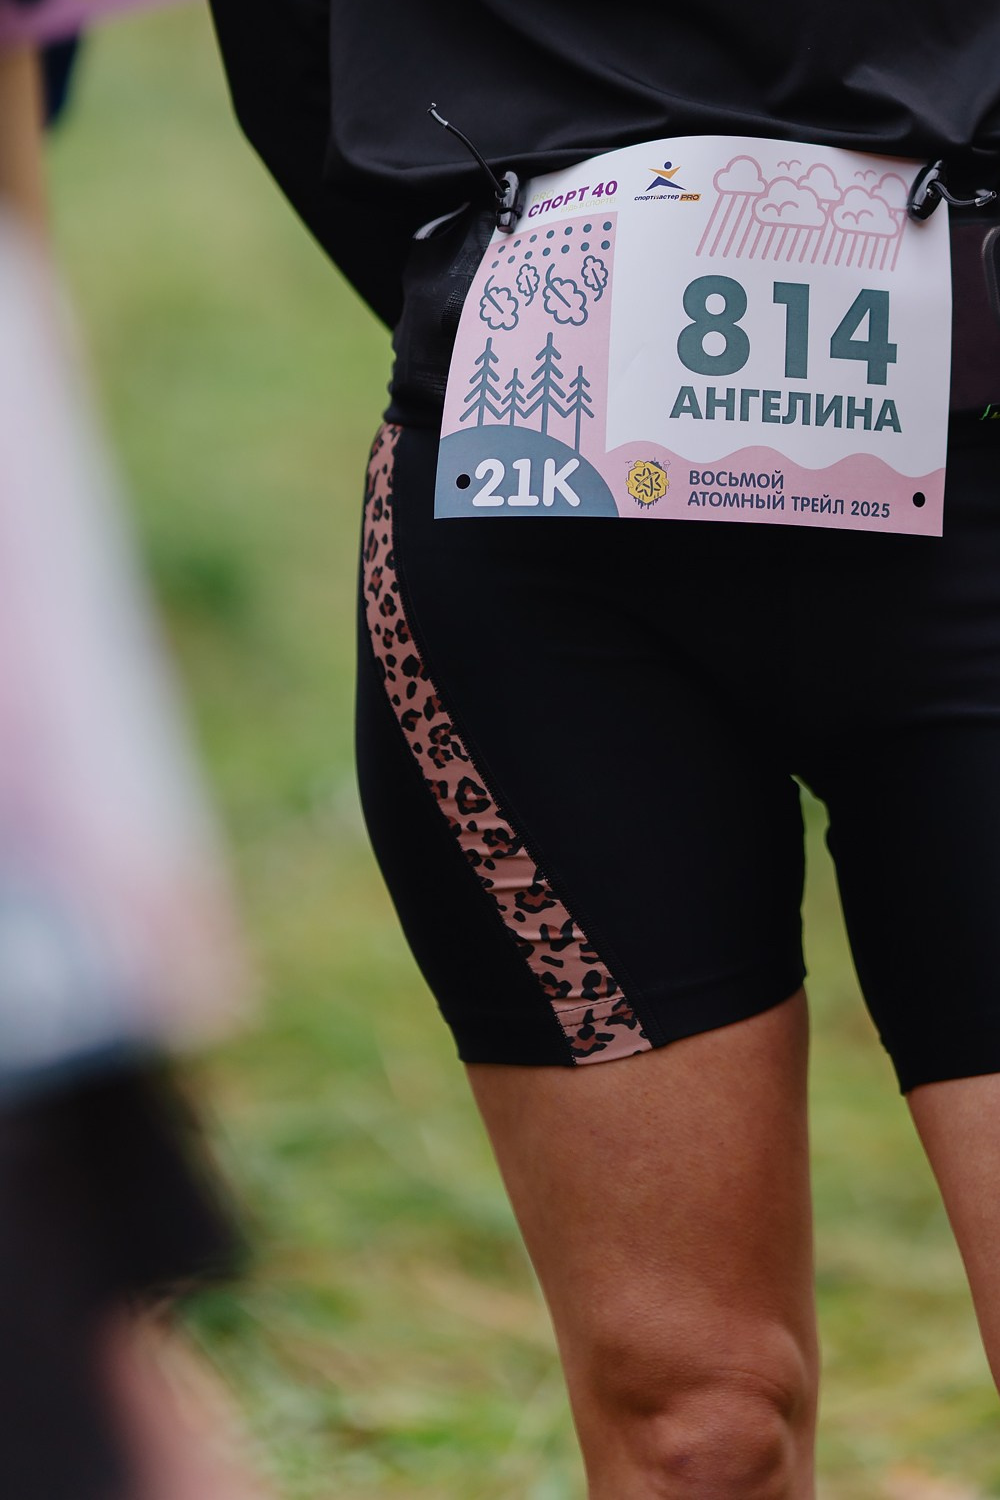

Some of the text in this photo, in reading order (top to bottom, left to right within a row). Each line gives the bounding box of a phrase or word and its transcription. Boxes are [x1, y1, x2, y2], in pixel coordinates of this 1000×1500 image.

[528, 180, 618, 218] СПОРТ 40
[677, 275, 897, 385] 814
[669, 386, 902, 433] АНГЕЛИНА
[472, 458, 581, 507] 21K
[689, 470, 784, 490] ВОСЬМОЙ
[688, 491, 890, 518] АТОМНЫЙ ТРЕЙЛ 2025
